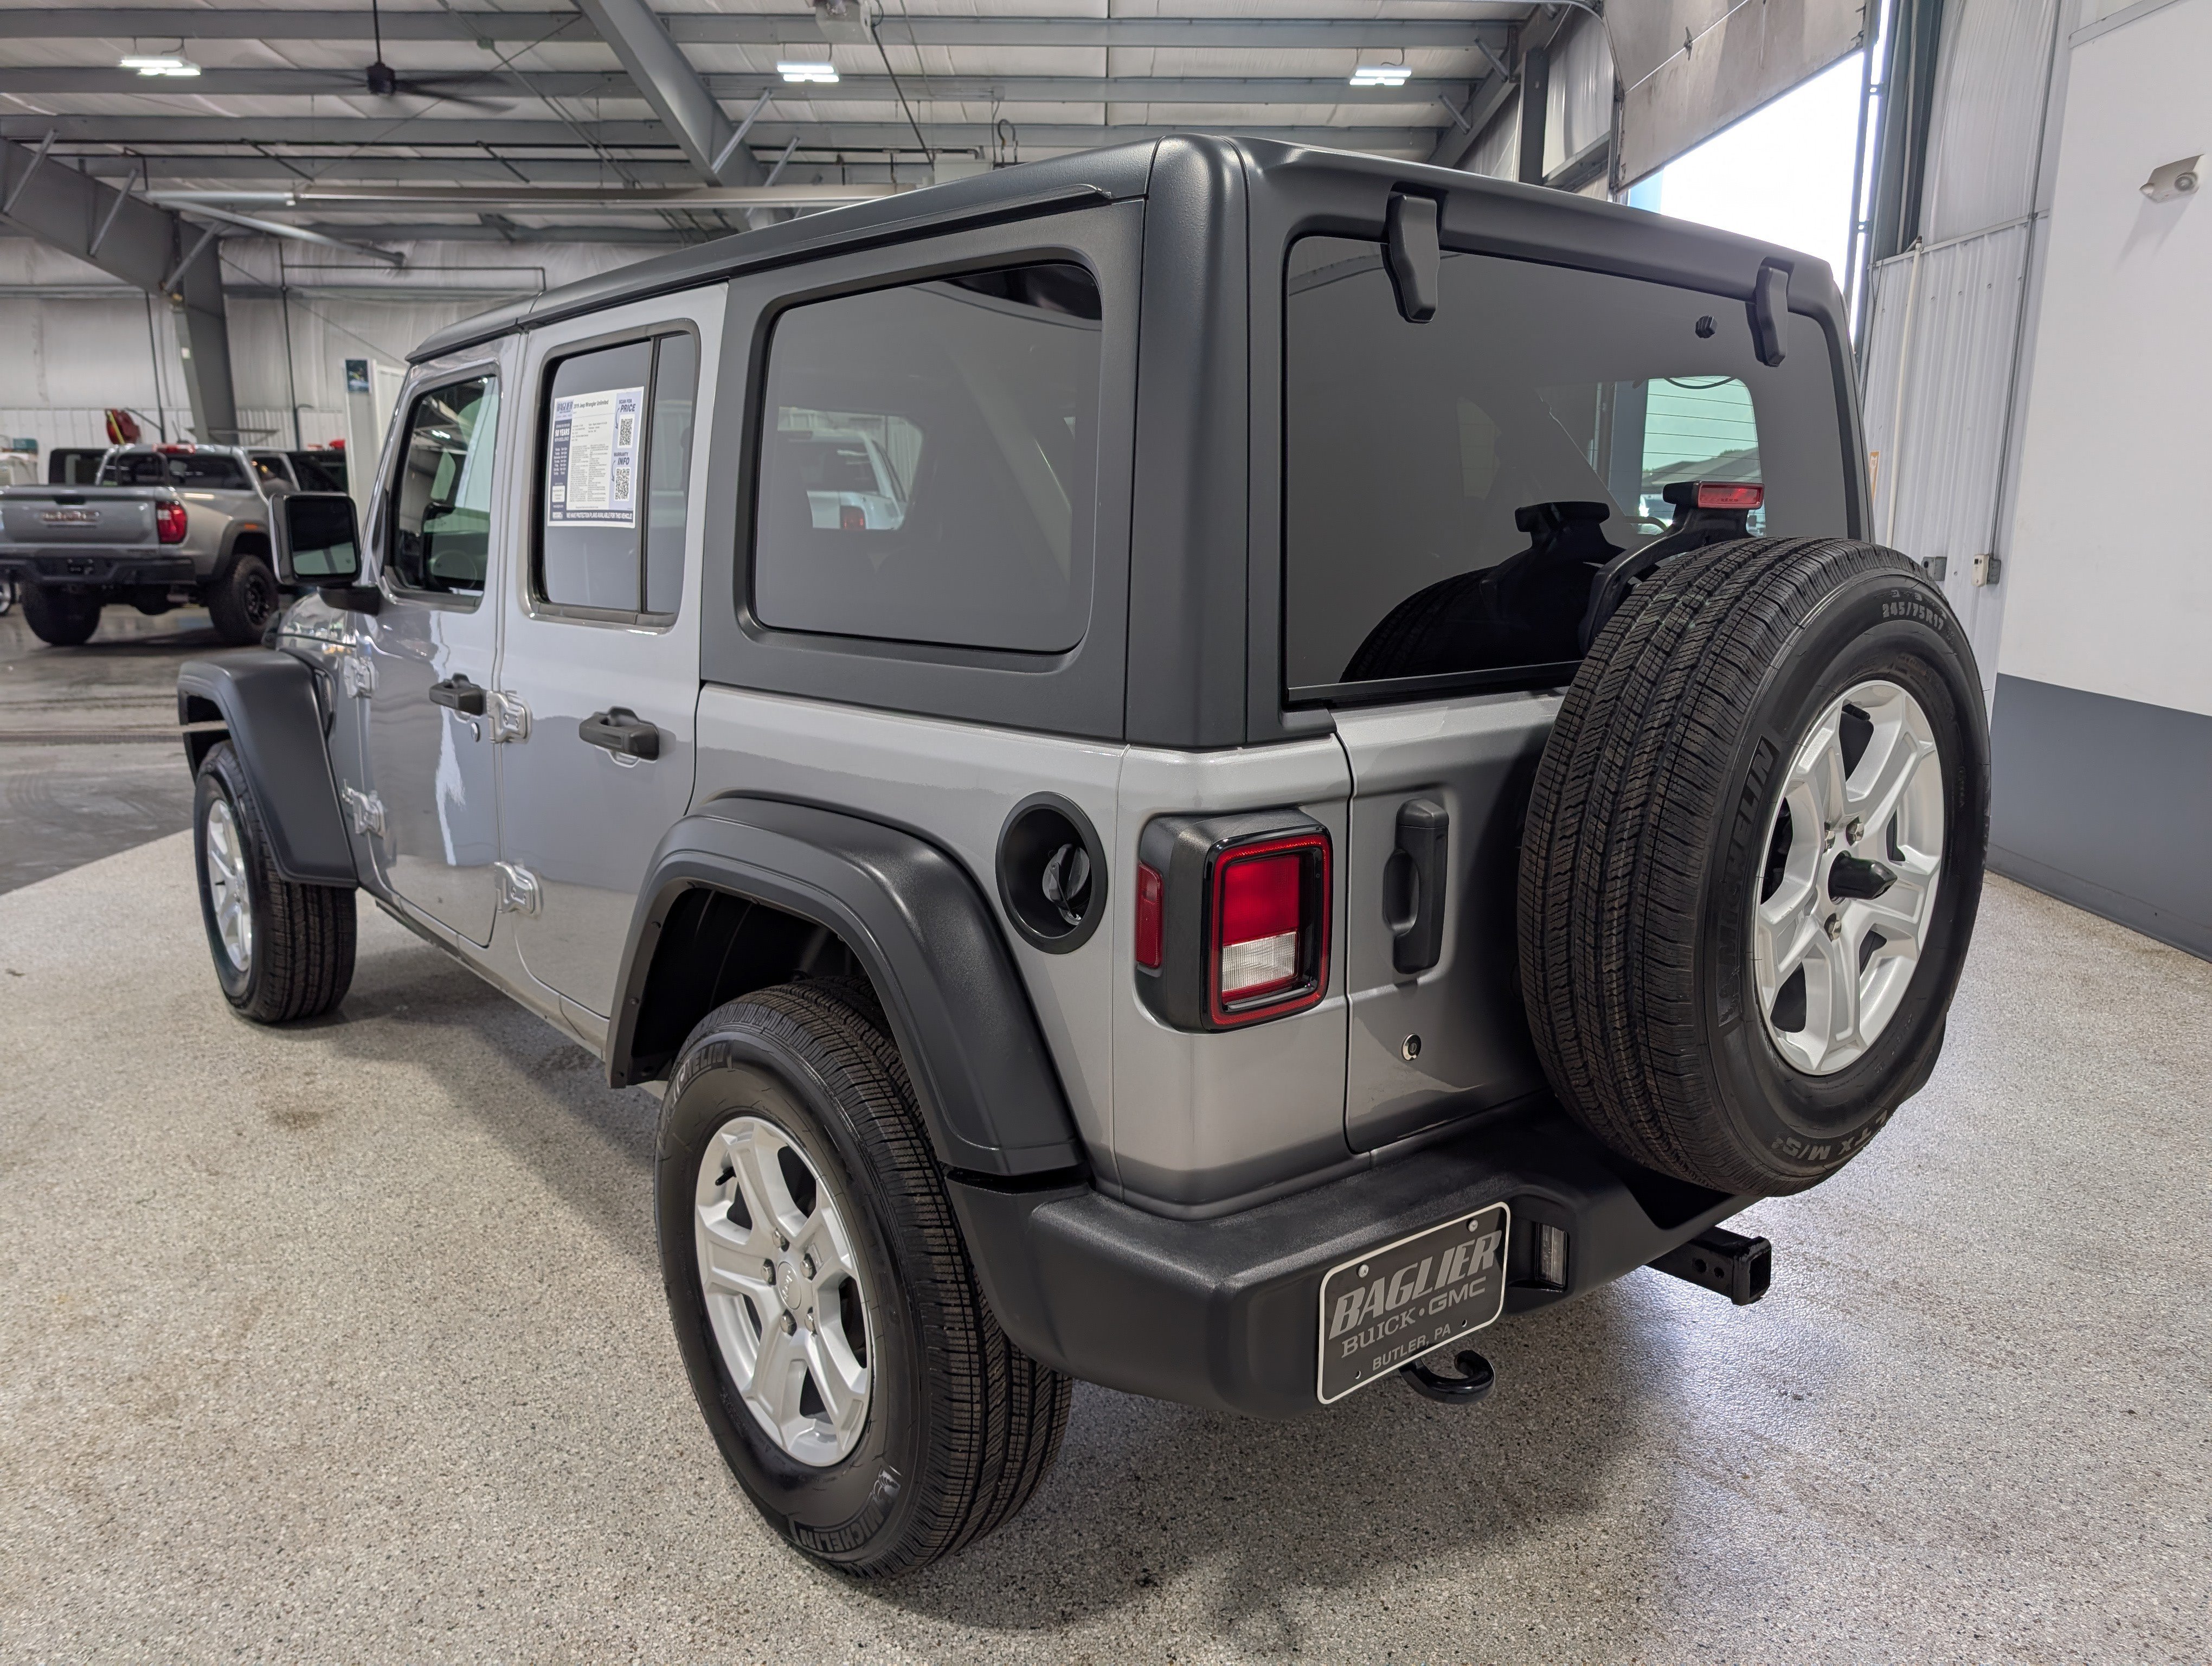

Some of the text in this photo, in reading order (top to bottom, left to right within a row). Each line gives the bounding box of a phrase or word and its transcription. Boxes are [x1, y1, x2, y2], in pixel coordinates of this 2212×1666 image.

[620, 403, 636, 413] PRICE
[560, 428, 570, 436] YEARS
[618, 457, 630, 466] INFO
[1882, 601, 1944, 631] 245/75R17
[1328, 1229, 1502, 1341] BAGLIER
[1341, 1276, 1487, 1359] BUICK GMC
[1372, 1323, 1451, 1372] BUTLER, PA
[799, 1501, 884, 1552] MICHELIN
